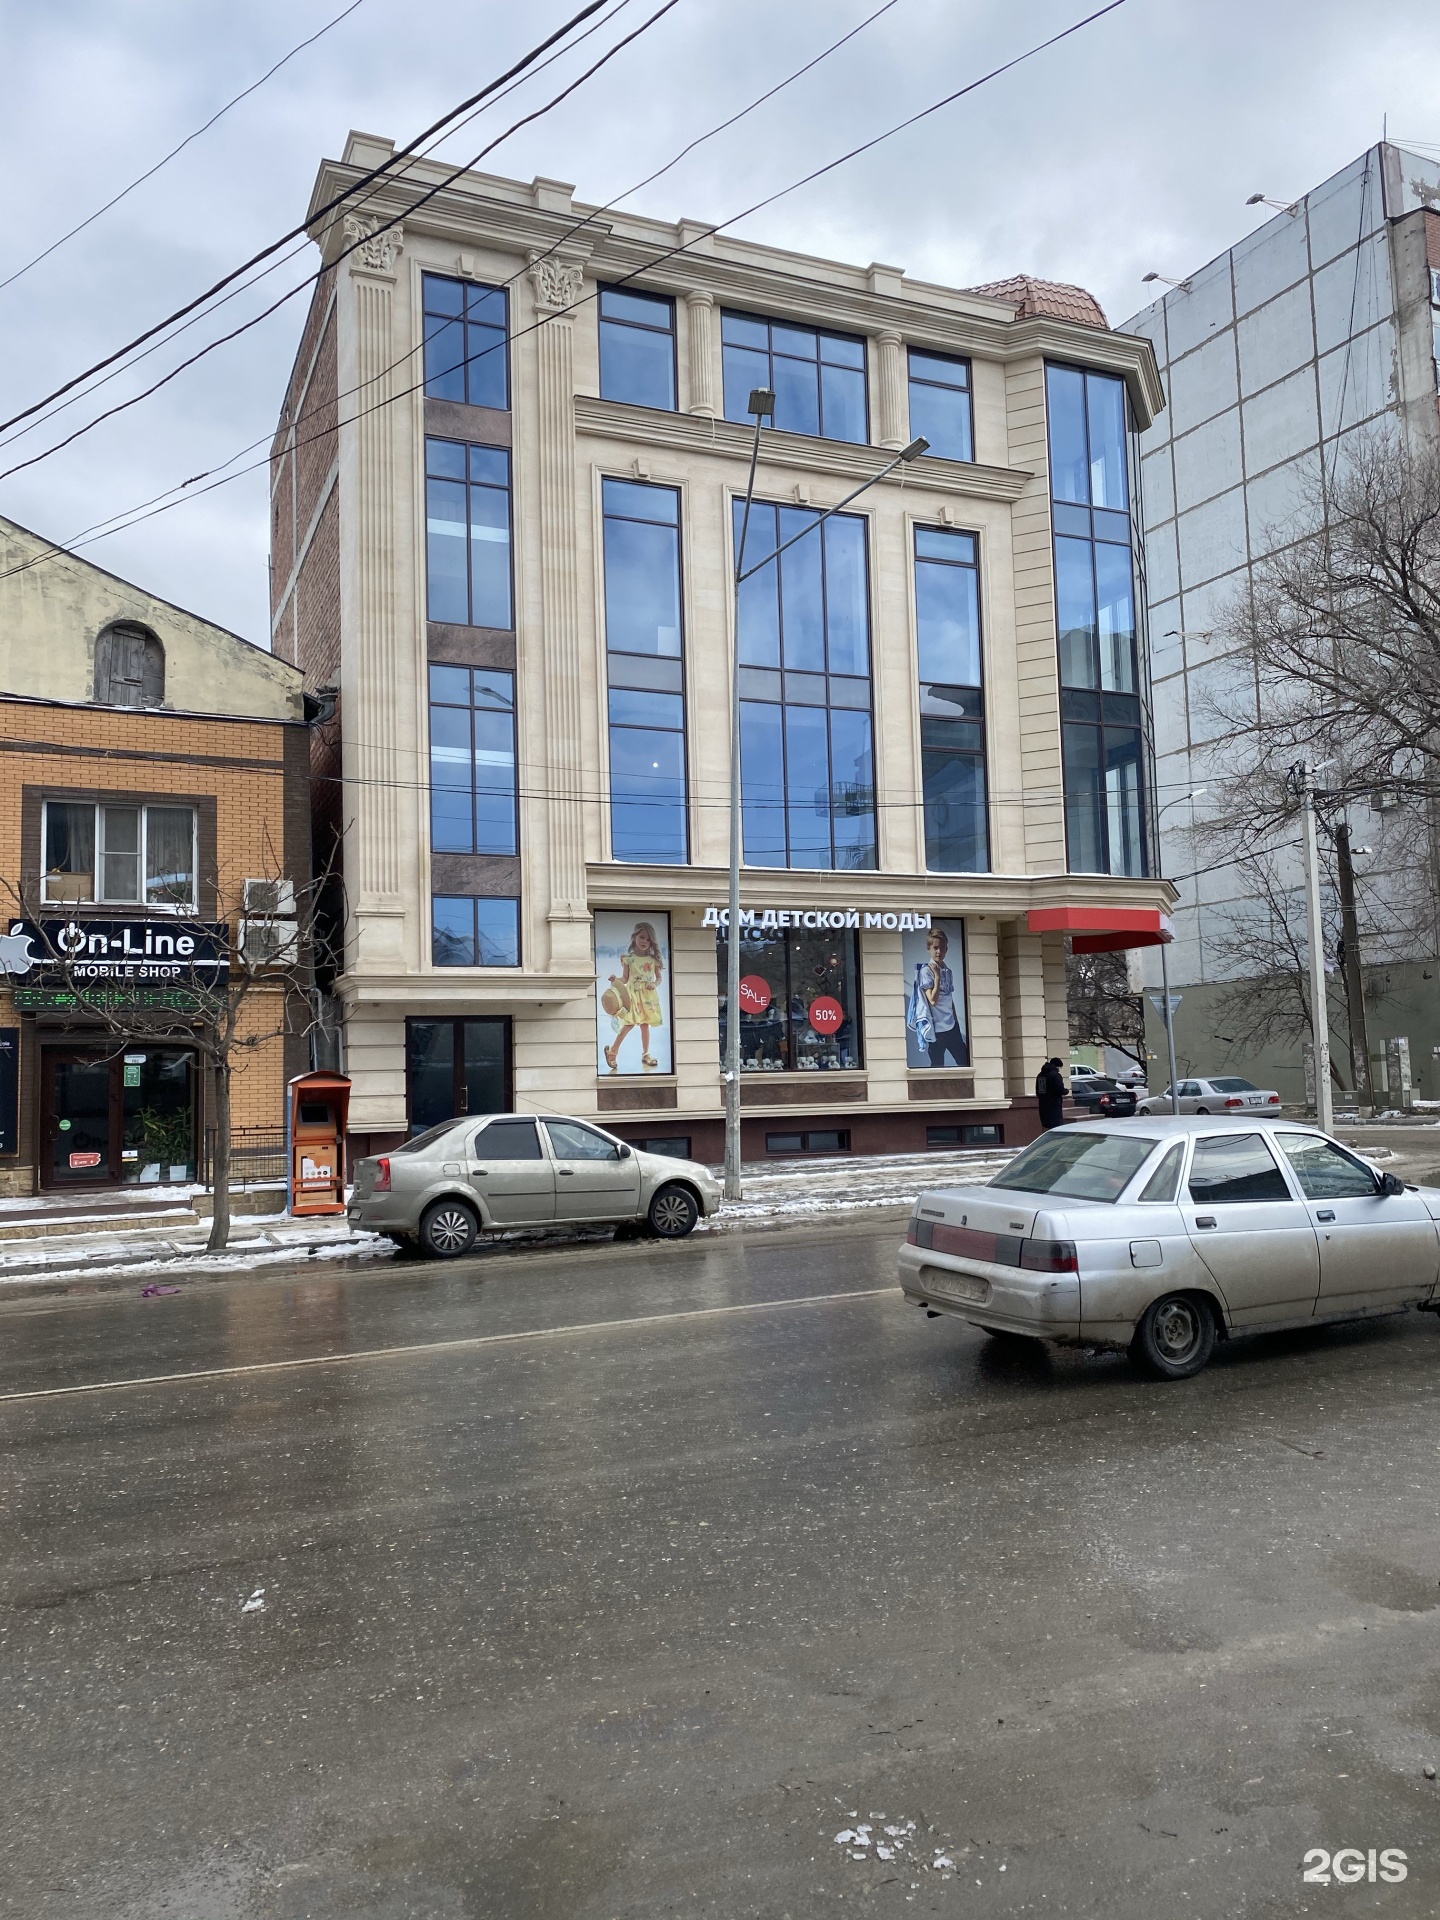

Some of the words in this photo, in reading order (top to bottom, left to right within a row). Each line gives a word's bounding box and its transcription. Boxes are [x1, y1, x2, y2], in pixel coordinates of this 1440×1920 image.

[702, 907, 755, 928] ДОМ
[761, 908, 860, 929] ДЕТСКОЙ
[864, 912, 932, 931] МОДЫ
[57, 922, 195, 955] On-Line
[138, 966, 181, 978] SHOP
[740, 984, 768, 1006] SALE
[815, 1009, 837, 1021] 50%
